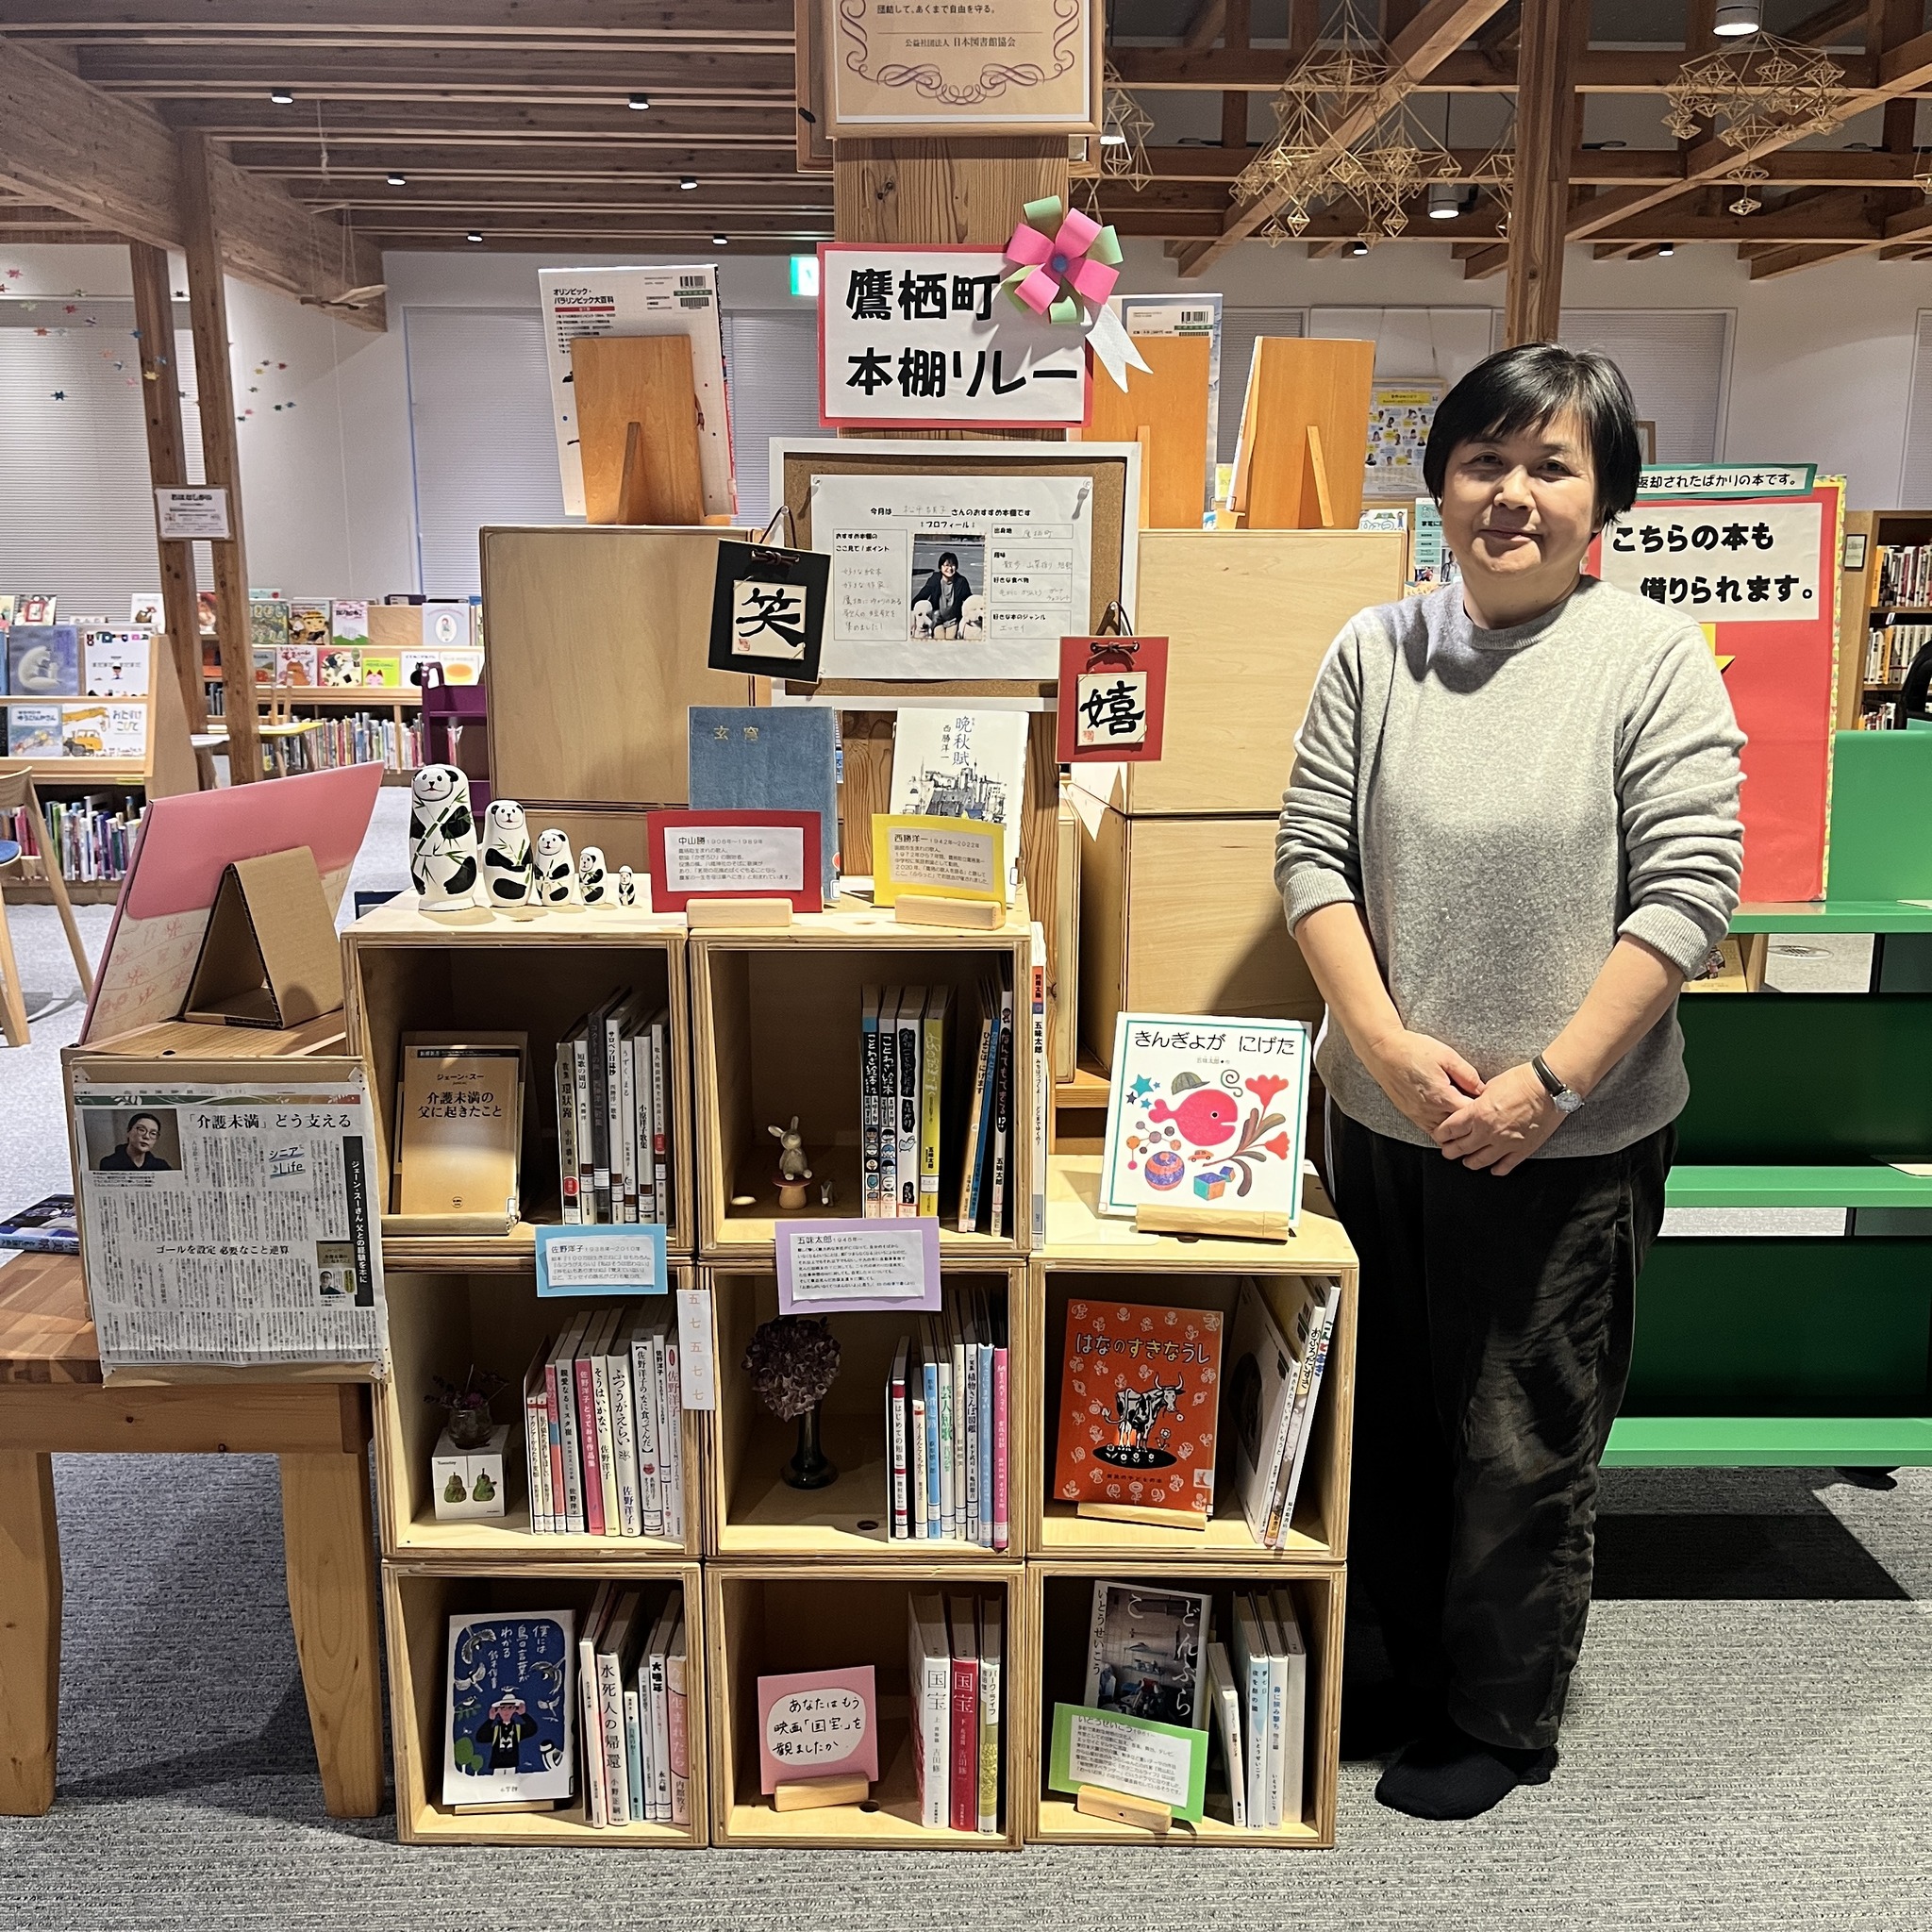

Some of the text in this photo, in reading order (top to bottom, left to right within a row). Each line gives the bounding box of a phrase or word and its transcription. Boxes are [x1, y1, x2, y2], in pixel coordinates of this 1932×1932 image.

[876, 4, 995, 14] 団結して、あくまで自由を守る。
[953, 37, 1016, 47] 日本図書館協会
[554, 295, 614, 305] パラリンピック大百科
[845, 268, 1001, 321] 鷹栖町
[845, 347, 1077, 397] 本棚リレー
[951, 508, 1031, 517] さんのおすすめ本棚です
[1612, 523, 1774, 553] こちらの本も
[1641, 575, 1812, 603] 借りられます。
[736, 587, 806, 648] 笑
[1079, 679, 1145, 735] 嬉
[941, 724, 951, 759] 西勝洋一
[952, 716, 971, 766] 晩秋賦
[980, 1031, 991, 1061] ひよこは
[1034, 1021, 1043, 1054] 五味太郎
[1134, 1030, 1295, 1056] きんぎょが にげた
[436, 1072, 485, 1081] ジェーン・スー
[576, 1053, 587, 1090] 短歌の周辺
[882, 1036, 894, 1095] ことわざ絵本
[417, 1105, 503, 1119] 父に起きたこと
[427, 1091, 494, 1105] 介護未満の
[188, 1113, 352, 1130] 「介護未満」どう支える
[270, 1146, 299, 1160] シニア
[279, 1161, 304, 1174] Life
[995, 1158, 1004, 1185] 五味太郎
[351, 1160, 364, 1222] ジェーン・スーさん
[156, 1244, 290, 1256] ゴールを設定 必要なこと逆算
[655, 1350, 664, 1376] 佐野洋子
[1076, 1332, 1211, 1364] はなのすきなうし
[667, 1371, 680, 1417] 佐野洋子
[967, 1373, 977, 1433] 植物さんぽ図鑑
[594, 1367, 611, 1480] そうはいかない 佐野洋子
[941, 1385, 953, 1441] 芸人短歌
[612, 1369, 634, 1524] ふつうがえらい 佐野洋子
[895, 1405, 904, 1461] はじめての短歌
[1127, 1593, 1143, 1619] こ
[501, 1626, 513, 1658] わかる
[532, 1625, 550, 1654] 僕には
[1092, 1589, 1108, 1676] いとうせいこう
[516, 1624, 530, 1683] 鳥の言葉が
[1172, 1600, 1200, 1717] どんぶら
[790, 1697, 859, 1712] あなたはもう
[927, 1670, 947, 1710] 国宝
[953, 1671, 974, 1713] 国宝
[601, 1664, 622, 1769] 水死人の帰還
[1273, 1686, 1281, 1730] 鼻に挟み撃ち
[774, 1717, 861, 1735] 映画「国宝」を
[772, 1740, 840, 1756] 観ましたか
[675, 1780, 686, 1813] 内館牧子
